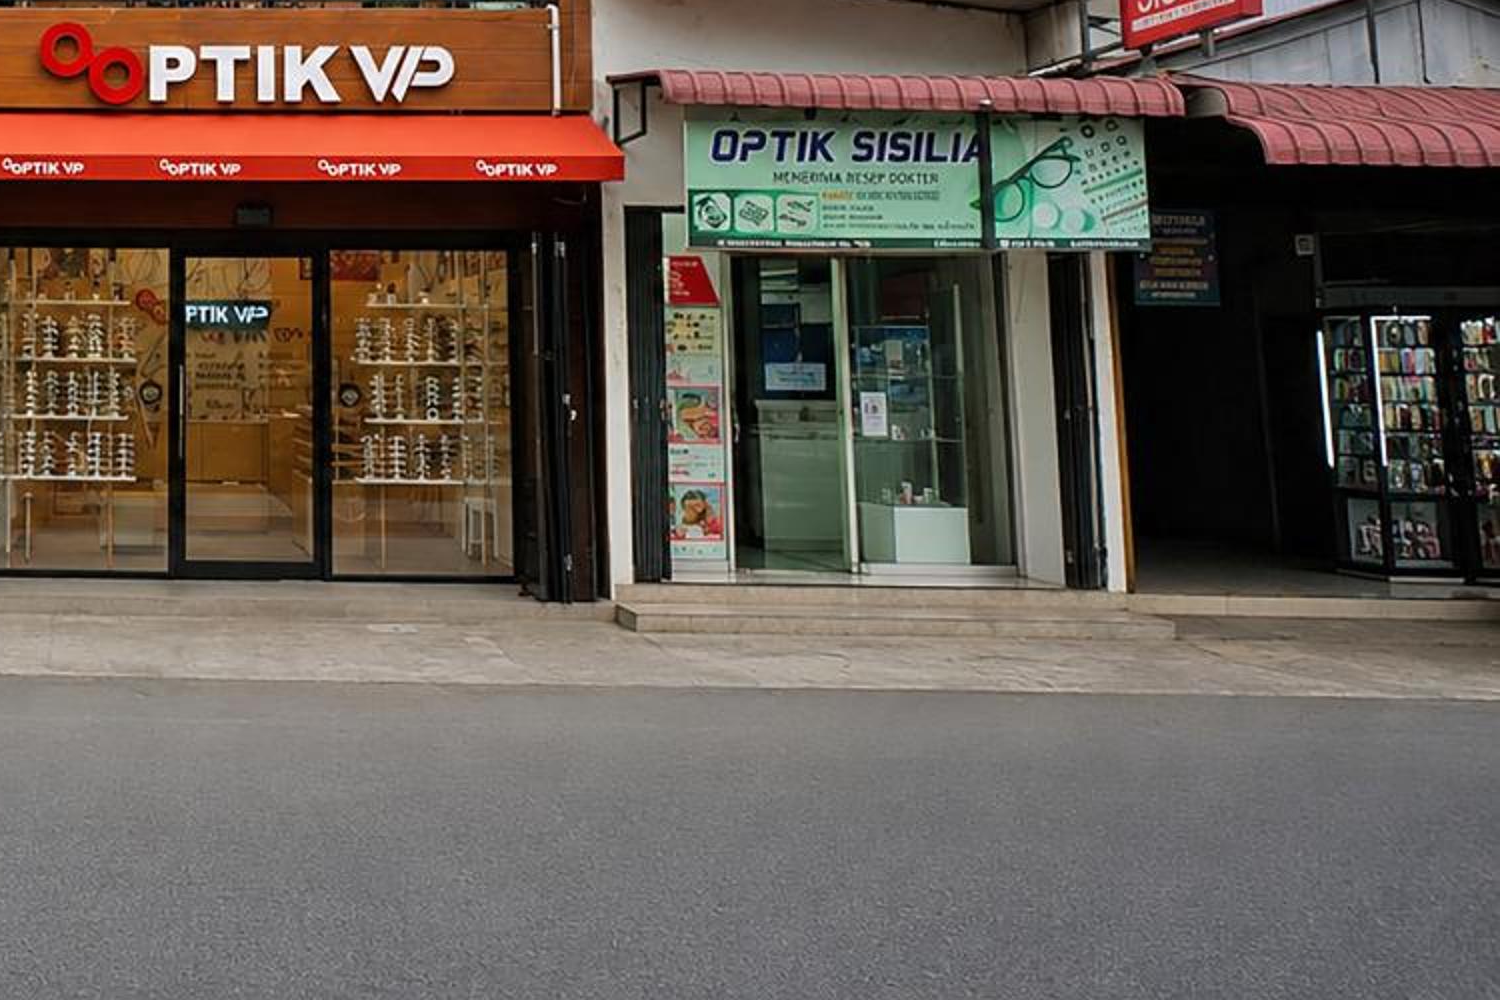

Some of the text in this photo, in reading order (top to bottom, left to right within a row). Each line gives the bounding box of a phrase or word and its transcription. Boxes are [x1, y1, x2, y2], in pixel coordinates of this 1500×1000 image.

[348, 45, 456, 103] VP
[711, 130, 836, 163] OPTIK
[62, 162, 85, 175] VP
[219, 163, 241, 175] VP
[378, 163, 401, 176] VP
[534, 163, 558, 176] VP
[233, 305, 269, 323] VP
